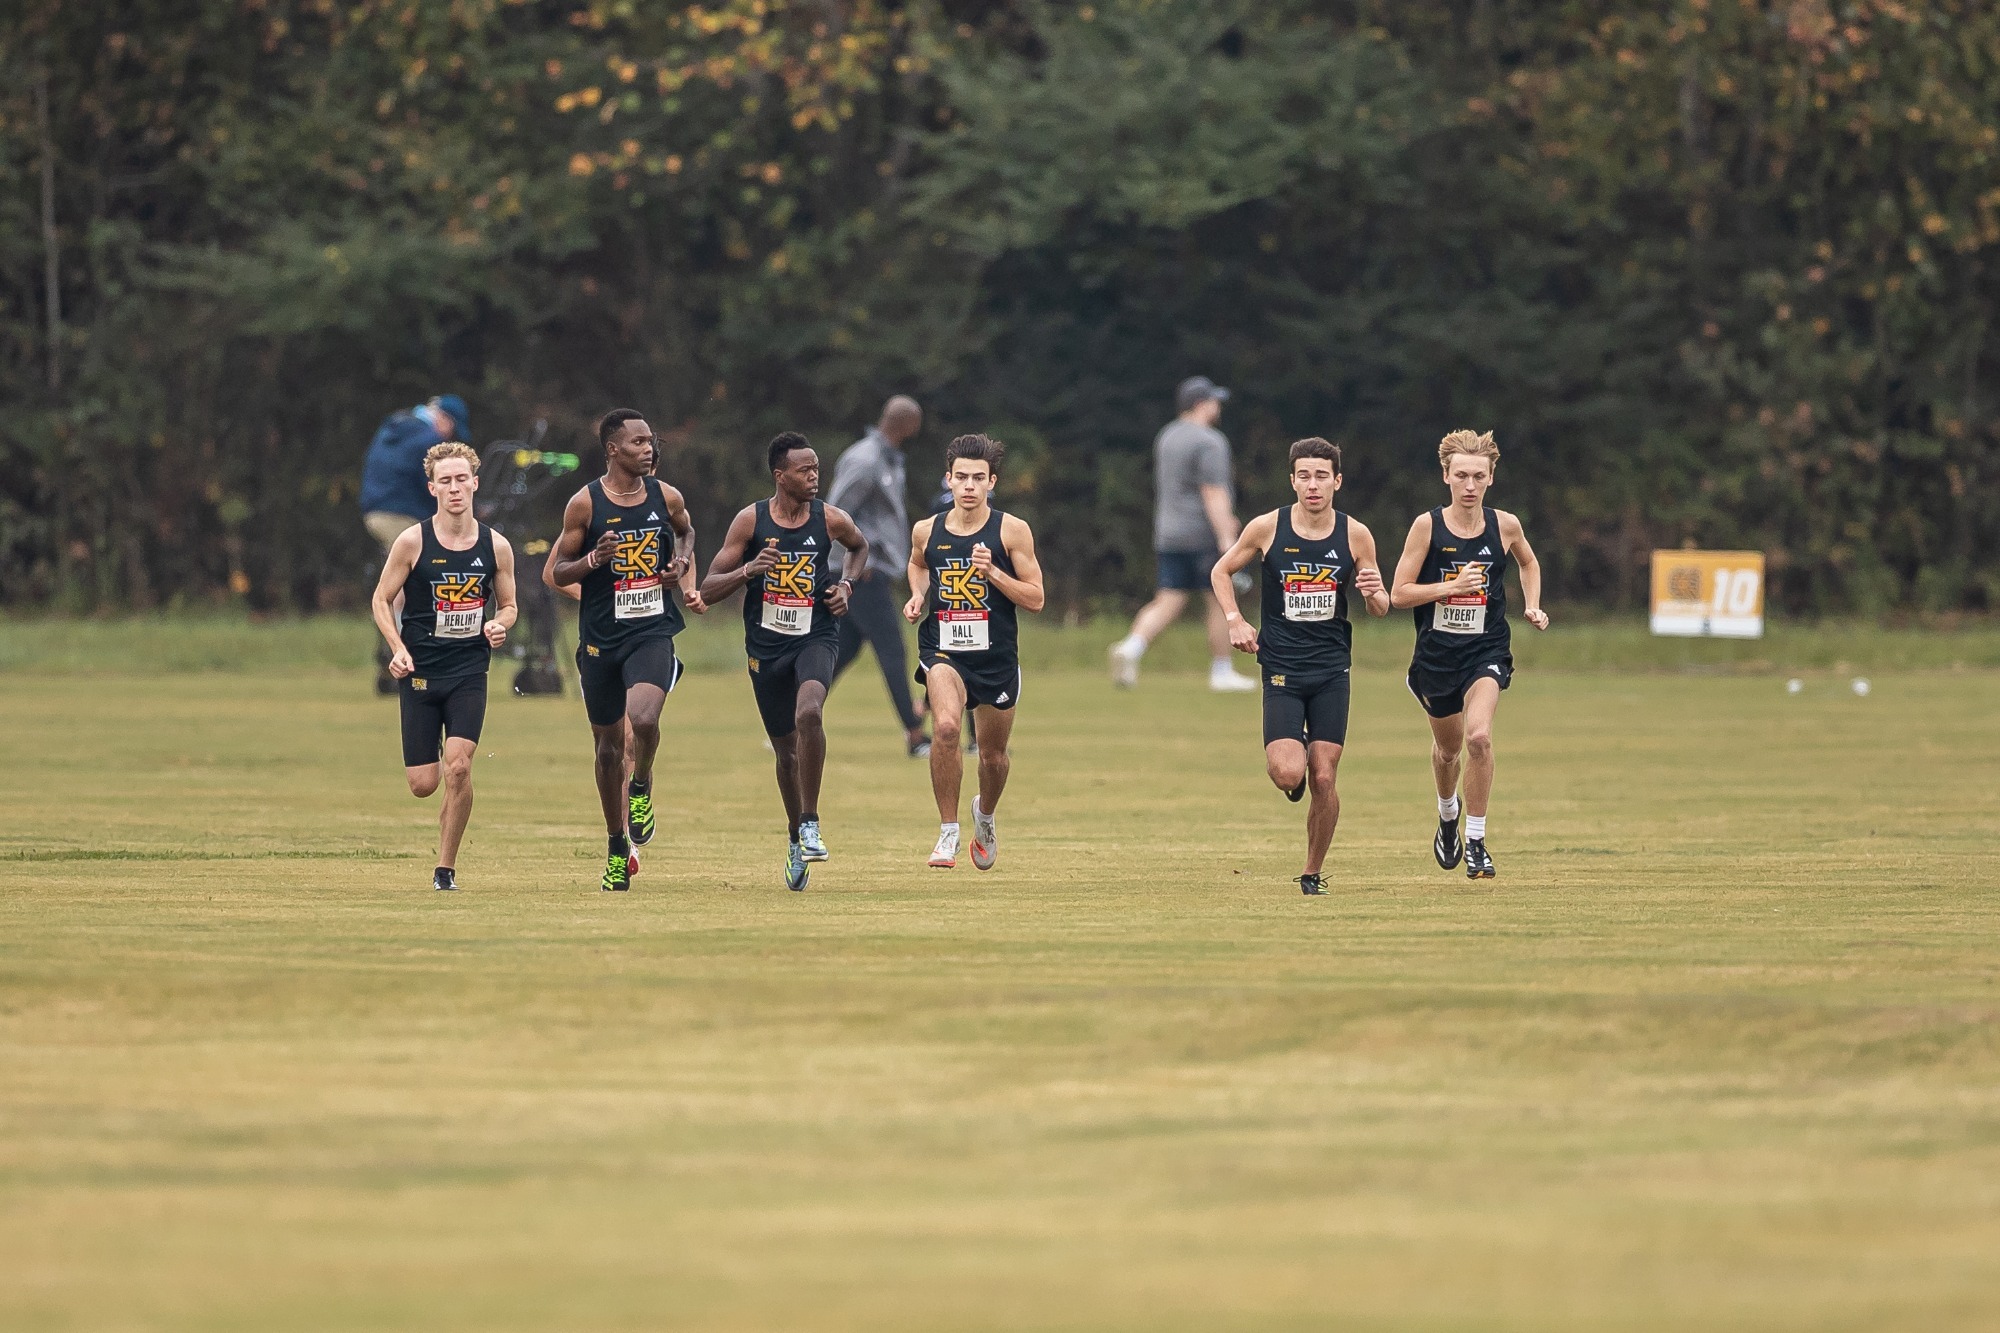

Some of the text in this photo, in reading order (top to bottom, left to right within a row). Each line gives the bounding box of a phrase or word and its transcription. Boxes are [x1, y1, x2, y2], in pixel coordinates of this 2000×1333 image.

[616, 588, 662, 606] KIPKEMBOI
[1713, 568, 1760, 613] 10
[1288, 594, 1333, 609] CRABTREE
[444, 612, 478, 627] HERLIHY
[775, 608, 798, 623] LIMO
[1443, 607, 1477, 622] SYBERT
[951, 624, 974, 638] HALL
